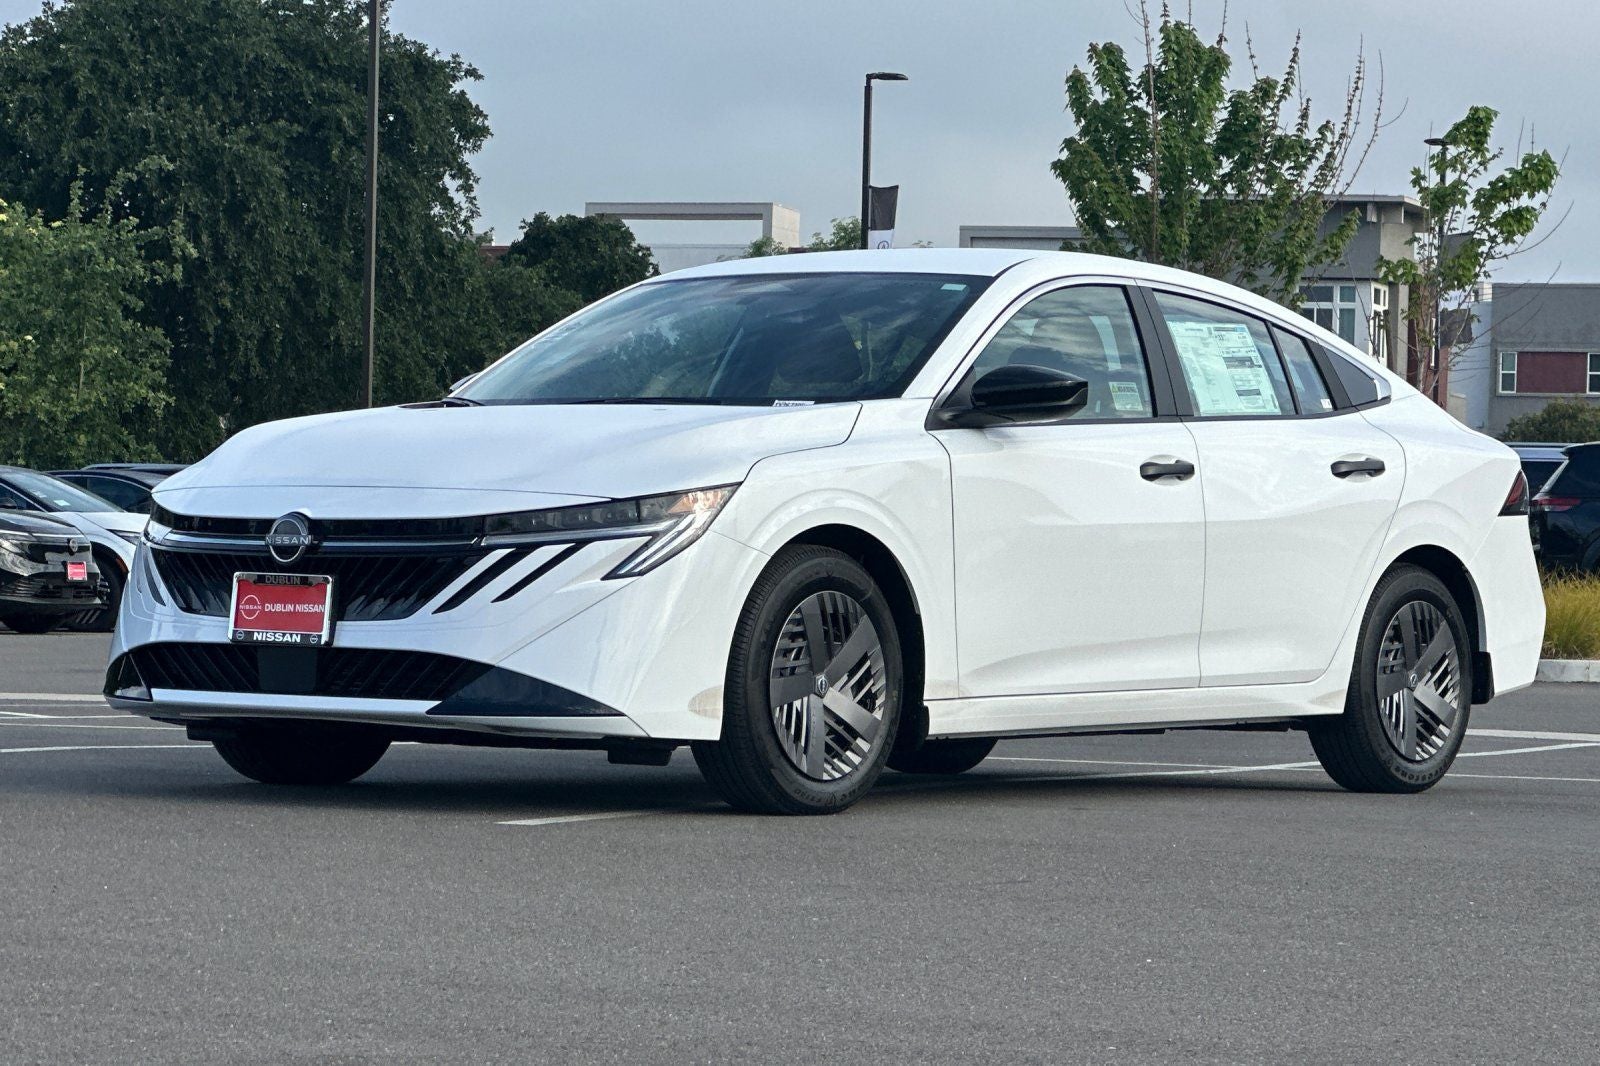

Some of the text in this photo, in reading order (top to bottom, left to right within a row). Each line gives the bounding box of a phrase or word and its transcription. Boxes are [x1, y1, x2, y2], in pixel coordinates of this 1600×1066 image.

[266, 535, 309, 545] NISSAN
[265, 575, 301, 585] DUBLIN
[264, 603, 325, 613] DUBLIN NISSAN
[253, 631, 301, 643] NISSAN
